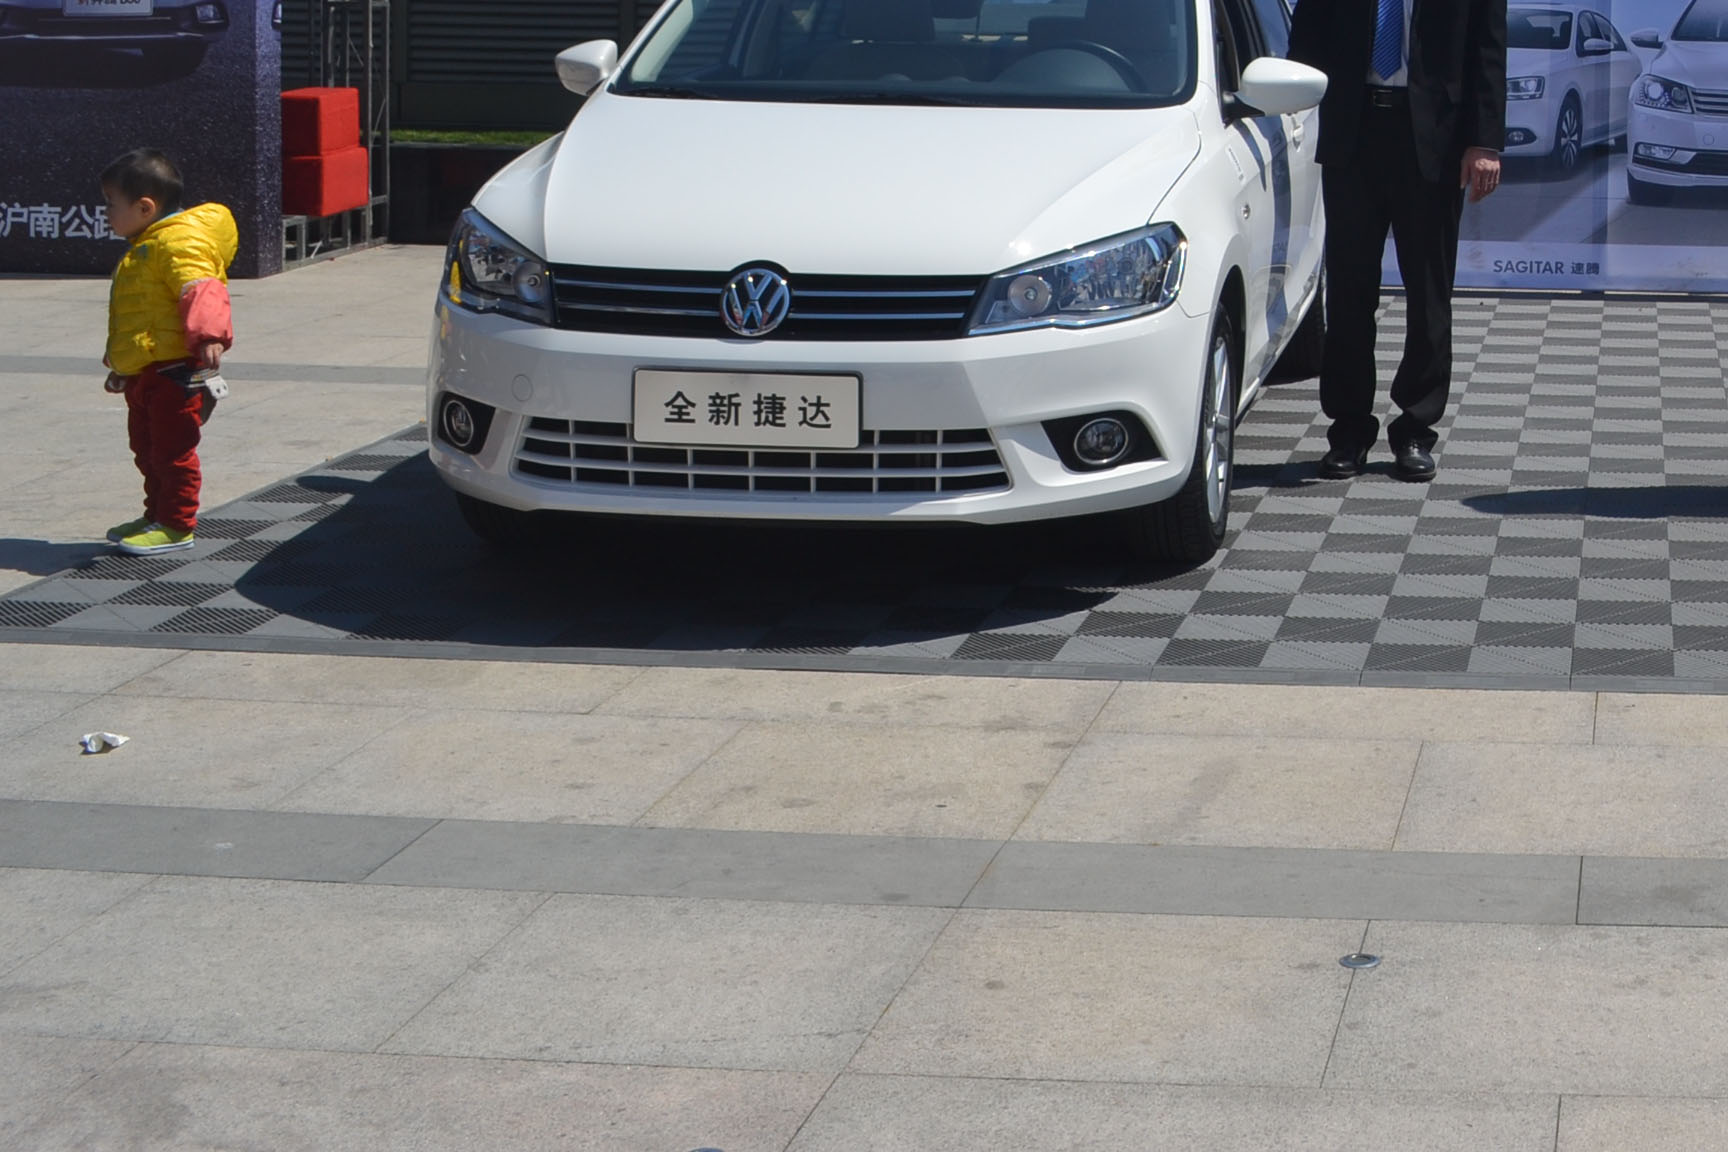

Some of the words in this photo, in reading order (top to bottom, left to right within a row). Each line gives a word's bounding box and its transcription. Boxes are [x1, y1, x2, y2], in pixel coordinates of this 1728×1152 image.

[1493, 260, 1564, 275] SAGITAR
[664, 391, 832, 429] 全新捷达
